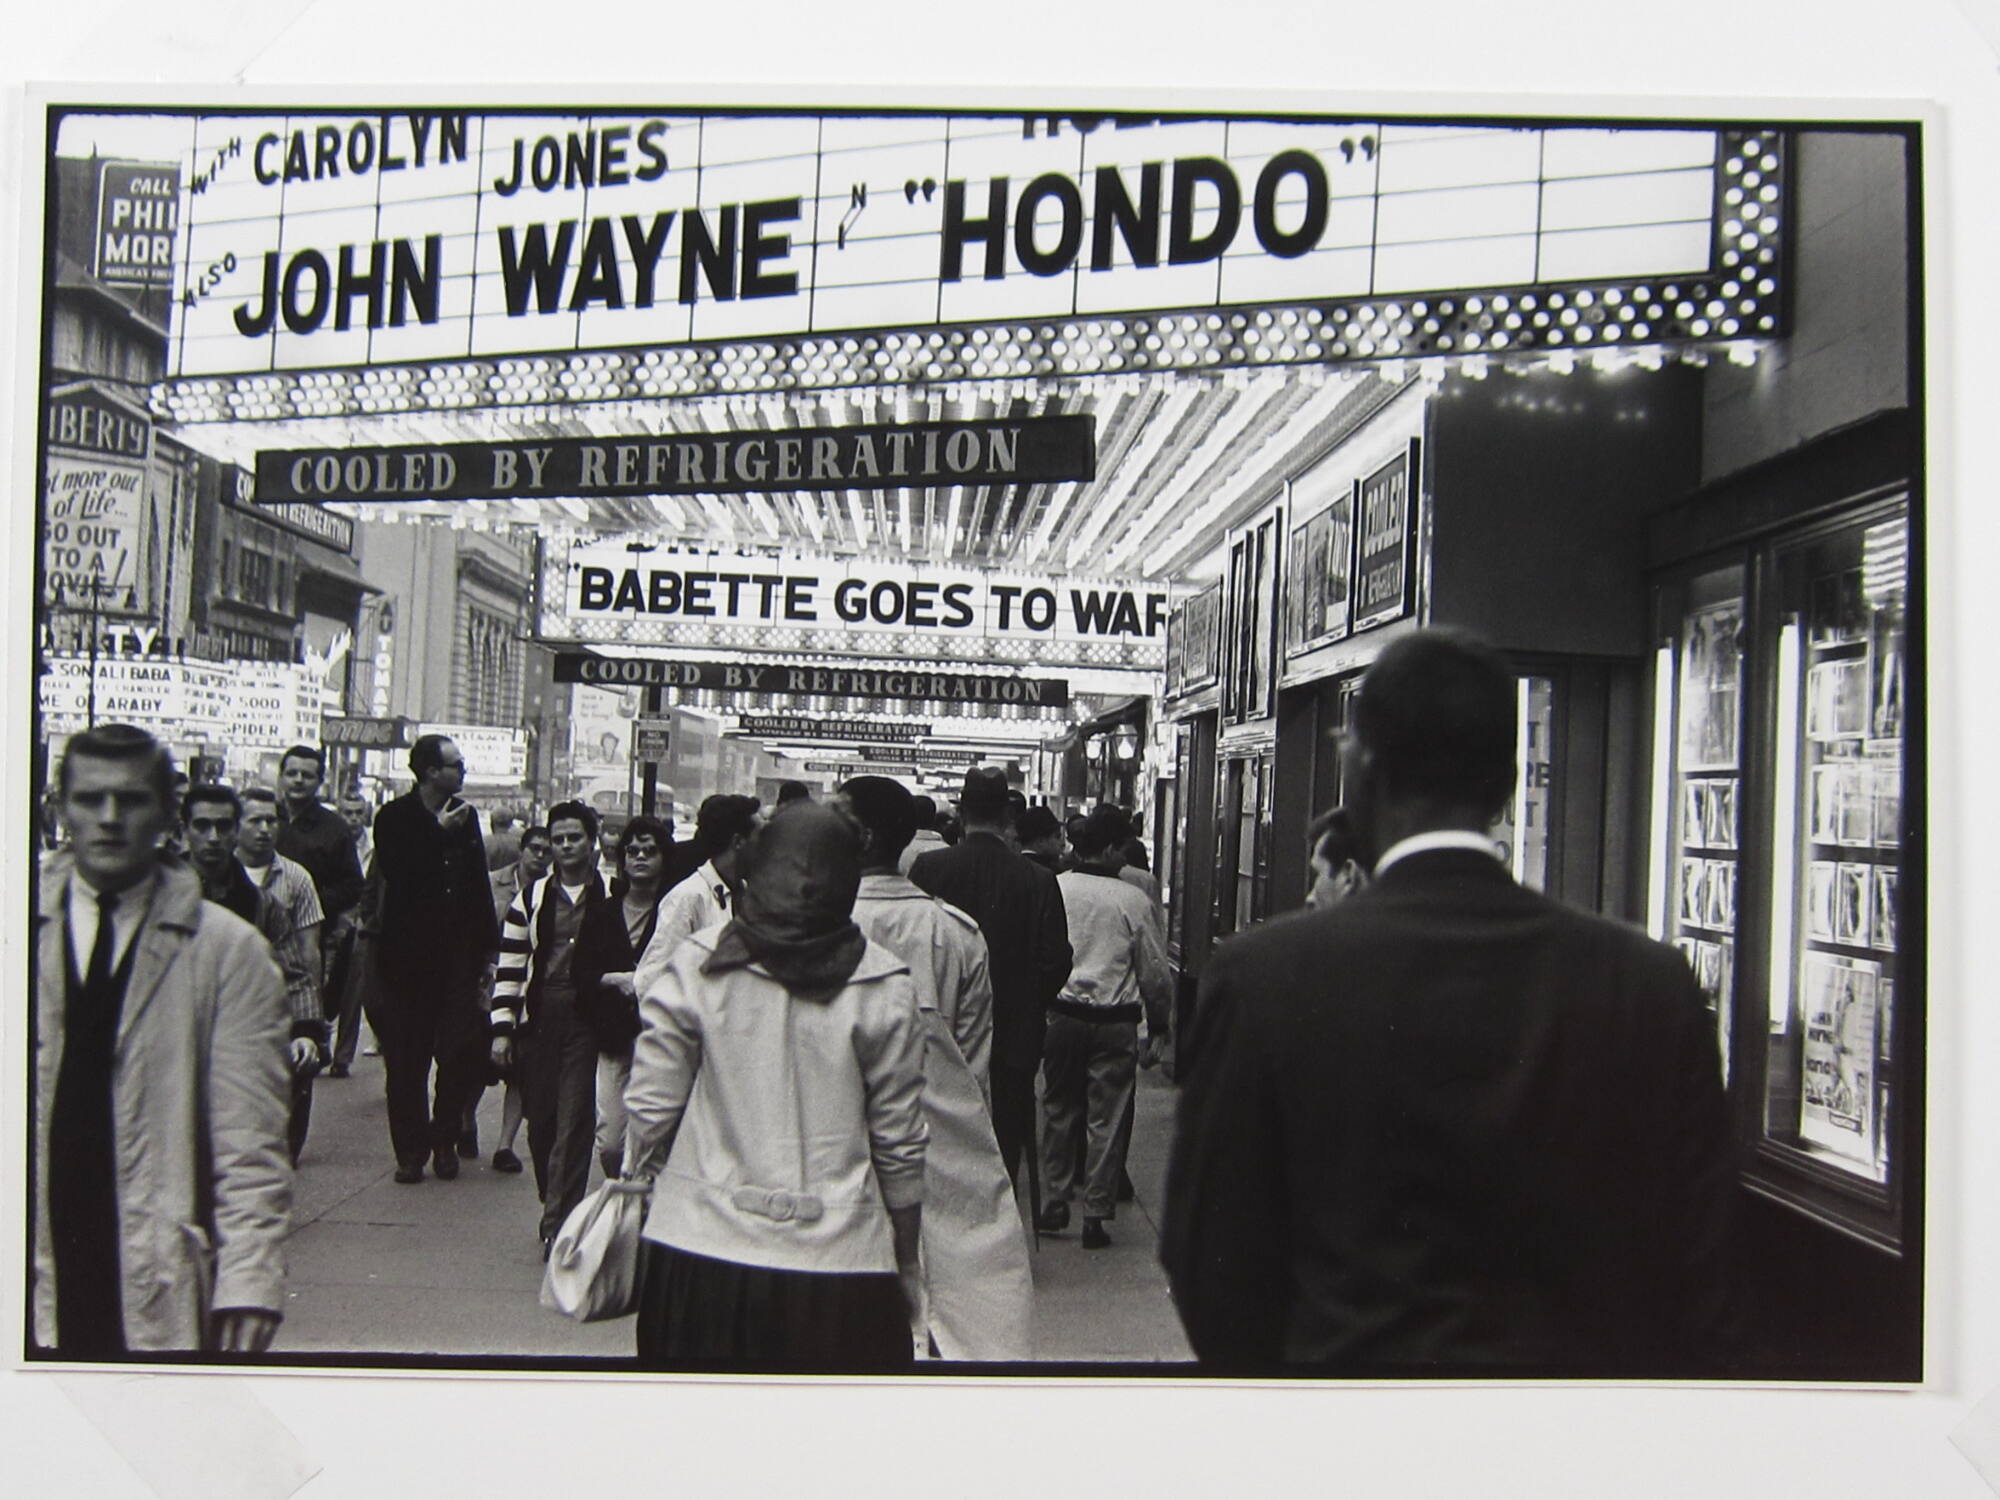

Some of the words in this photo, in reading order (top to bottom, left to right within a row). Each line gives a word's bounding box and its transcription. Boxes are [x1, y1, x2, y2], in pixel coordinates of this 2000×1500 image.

[191, 137, 242, 196] WITH
[254, 115, 467, 186] CAROLYN
[495, 119, 670, 198] JONES
[130, 177, 172, 196] CALL
[183, 252, 237, 308] ALSO
[233, 234, 443, 338] JOHN
[495, 196, 802, 317] WAYNE
[903, 134, 1377, 284] "HONDO"
[290, 453, 458, 495] COOLED
[492, 446, 554, 490] BY
[577, 426, 1023, 489] REFRIGERATION
[63, 470, 107, 491] more
[110, 472, 140, 493] out
[53, 490, 79, 518] of
[77, 525, 121, 549] OUT
[51, 546, 82, 569] TO
[88, 551, 105, 573] A
[834, 577, 975, 629] GOES
[990, 585, 1057, 631] TO
[98, 665, 125, 680] ALI
[130, 666, 172, 682] BABA
[580, 657, 701, 686] COOLED
[725, 666, 766, 689] BY
[788, 669, 1042, 703] REFRIGERATION
[106, 697, 162, 713] ARABY
[744, 717, 798, 730] COOLED
[801, 719, 816, 730] BY
[821, 721, 927, 735] REFRIGERATION
